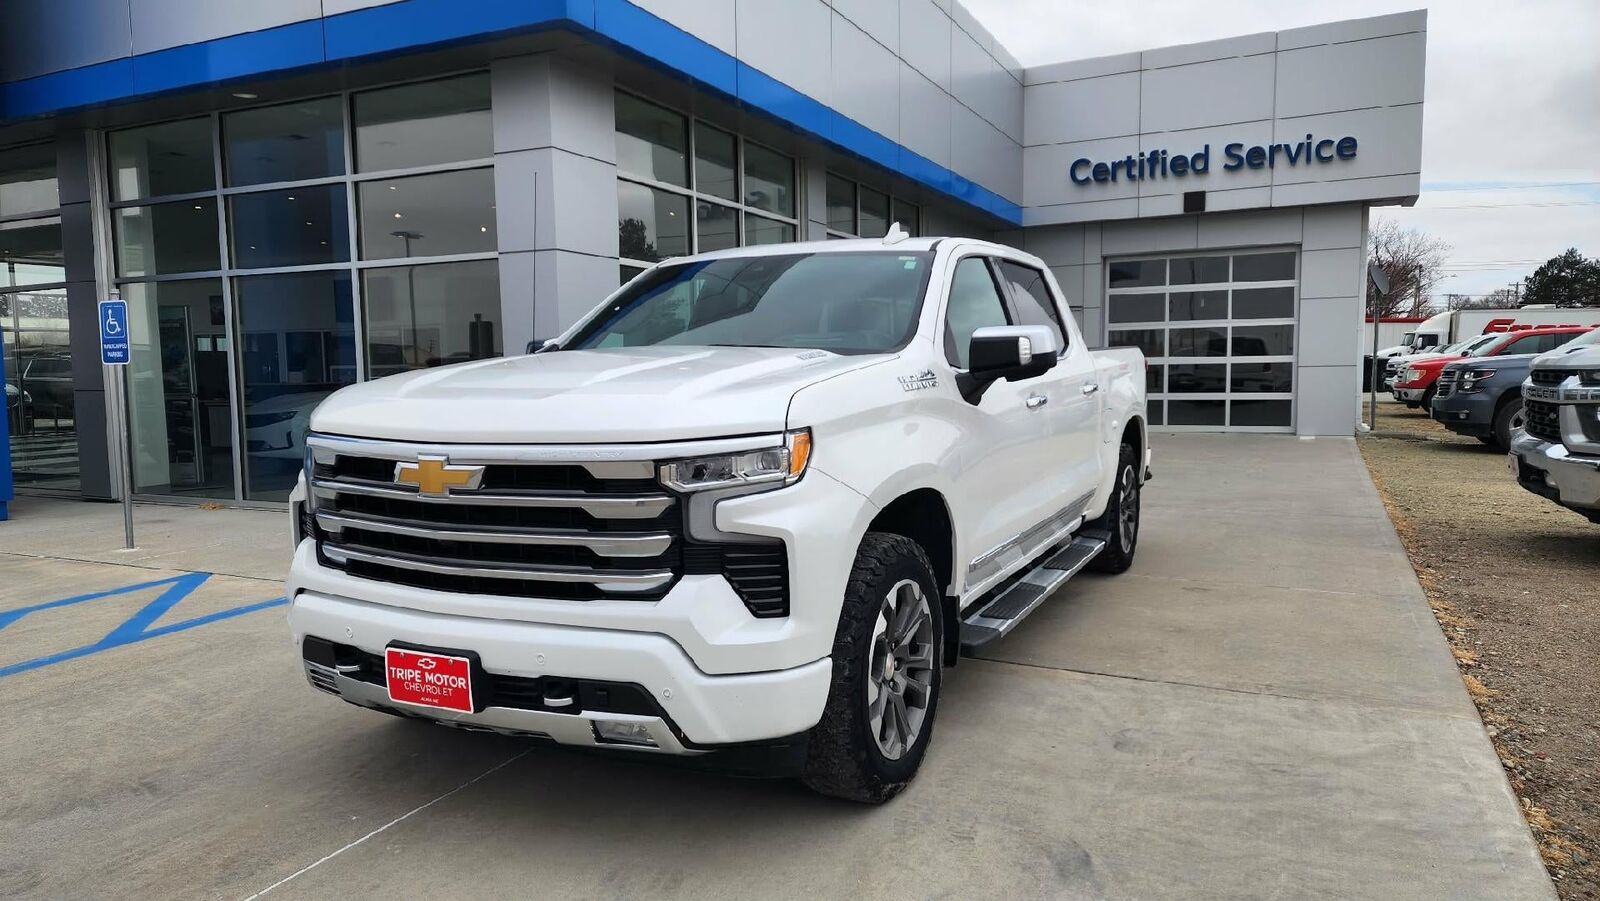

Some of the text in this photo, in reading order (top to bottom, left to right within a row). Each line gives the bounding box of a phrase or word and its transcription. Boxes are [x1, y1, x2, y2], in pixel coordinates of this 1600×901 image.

[1070, 133, 1358, 185] Certified Service
[390, 667, 467, 689] TRIPE MOTOR
[404, 682, 453, 696] CHEVROLET
